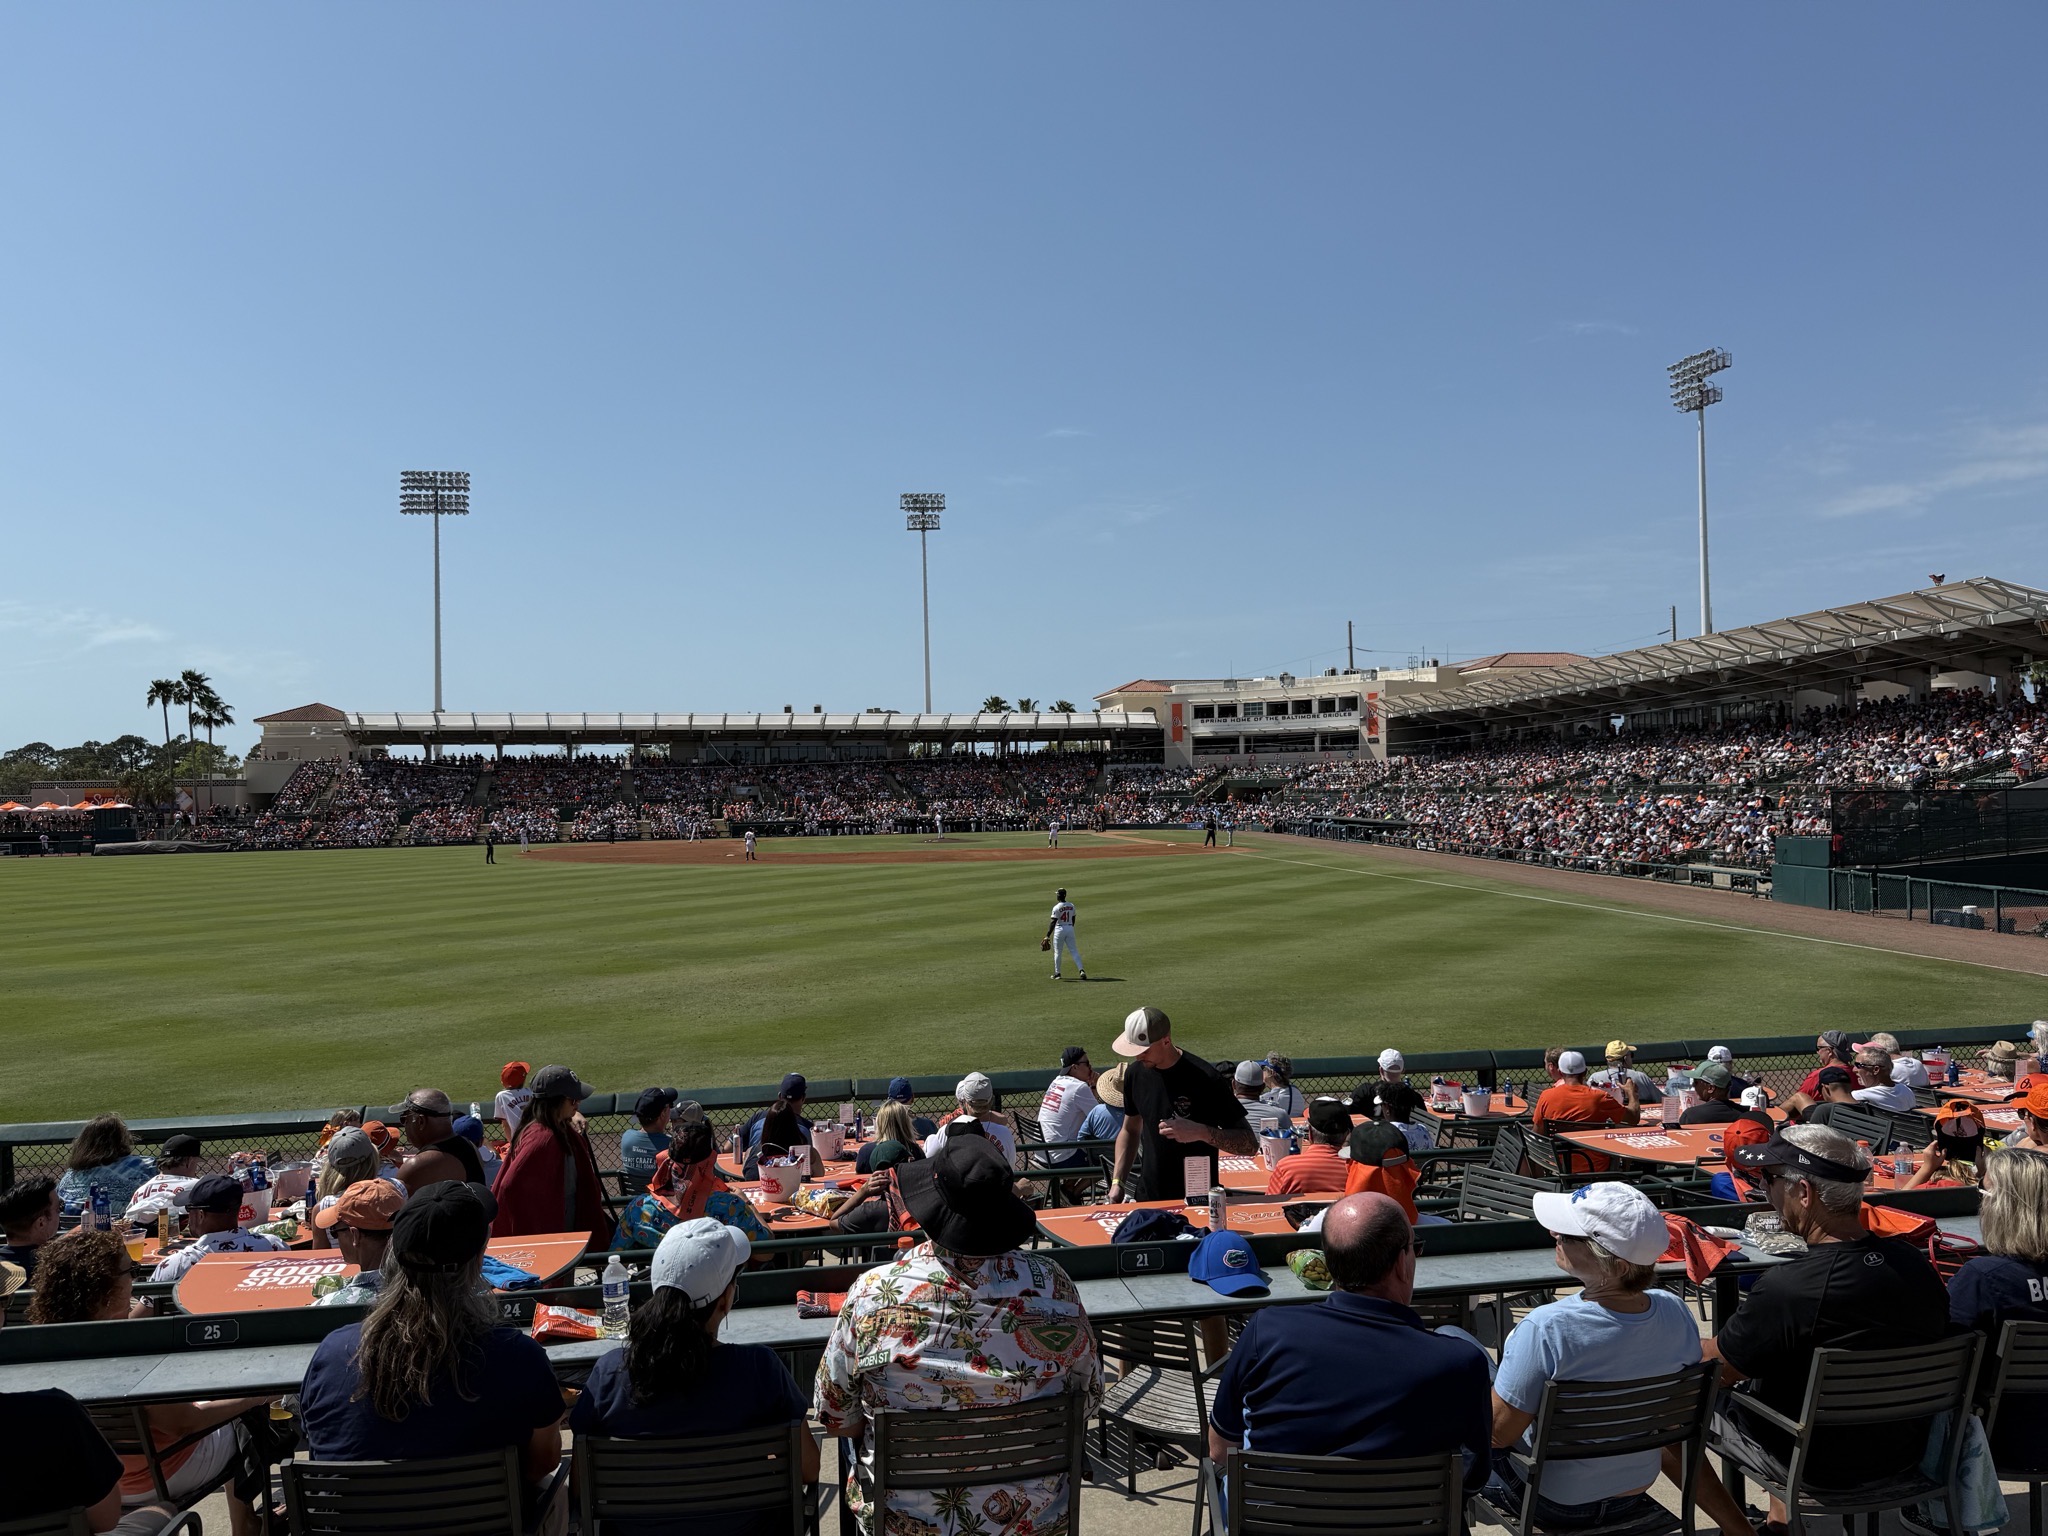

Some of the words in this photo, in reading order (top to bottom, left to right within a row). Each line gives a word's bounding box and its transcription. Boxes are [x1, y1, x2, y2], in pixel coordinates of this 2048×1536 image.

[93, 793, 131, 806] Surfsi
[1060, 911, 1070, 923] 41
[1136, 1253, 1149, 1267] 21
[248, 1264, 347, 1279] GOOD
[236, 1274, 338, 1289] SPOR
[504, 1303, 521, 1317] 24
[204, 1325, 221, 1340] 25
